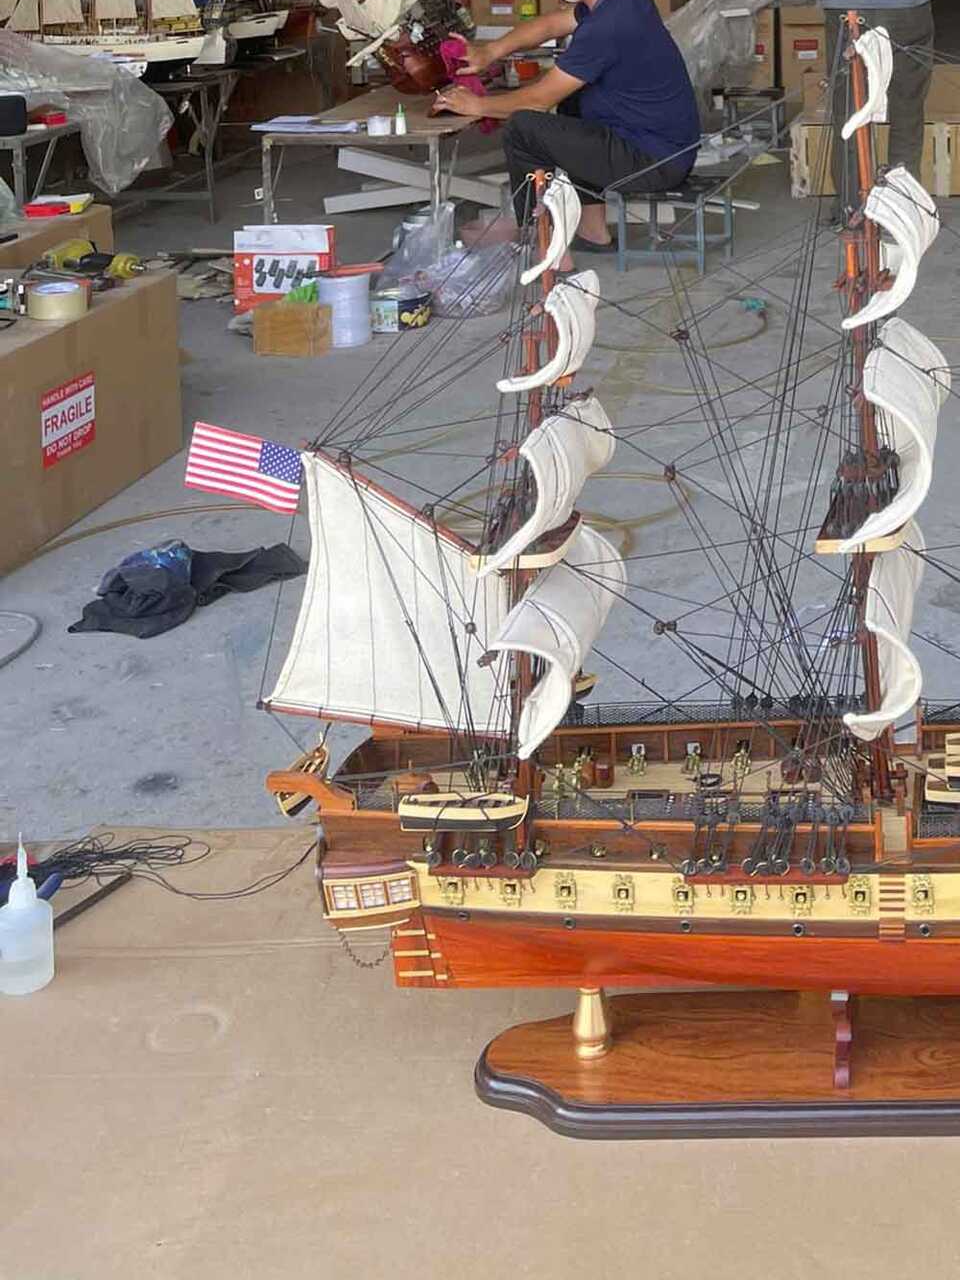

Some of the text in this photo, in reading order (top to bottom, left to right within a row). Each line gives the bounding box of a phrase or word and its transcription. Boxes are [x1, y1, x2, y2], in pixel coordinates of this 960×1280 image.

[44, 395, 93, 437] FRAGILE
[47, 422, 92, 457] DO NOT DROP
